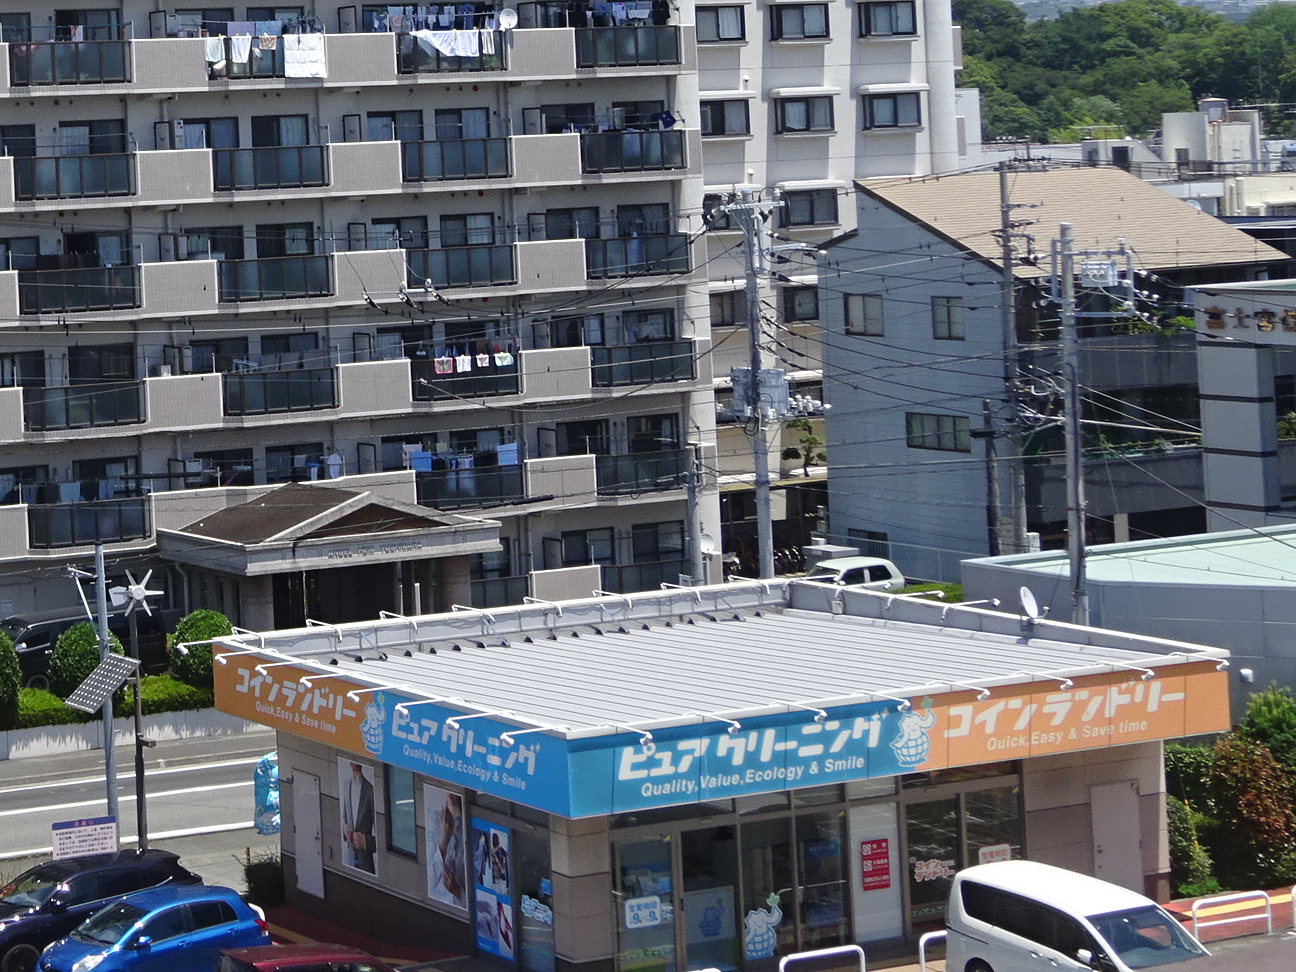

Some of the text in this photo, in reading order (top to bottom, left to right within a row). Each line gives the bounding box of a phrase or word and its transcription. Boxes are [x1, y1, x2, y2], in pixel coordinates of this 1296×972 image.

[235, 668, 357, 721] コインランドリー
[943, 679, 1185, 739] コインランドリー
[294, 714, 300, 723] &
[301, 714, 319, 728] Save
[320, 720, 336, 734] time
[1068, 727, 1077, 740] &
[1082, 725, 1114, 738] Save
[1119, 718, 1148, 734] time
[809, 760, 819, 774] &
[824, 756, 865, 772] Smile
[493, 771, 499, 783] &
[501, 773, 527, 791] Smile
